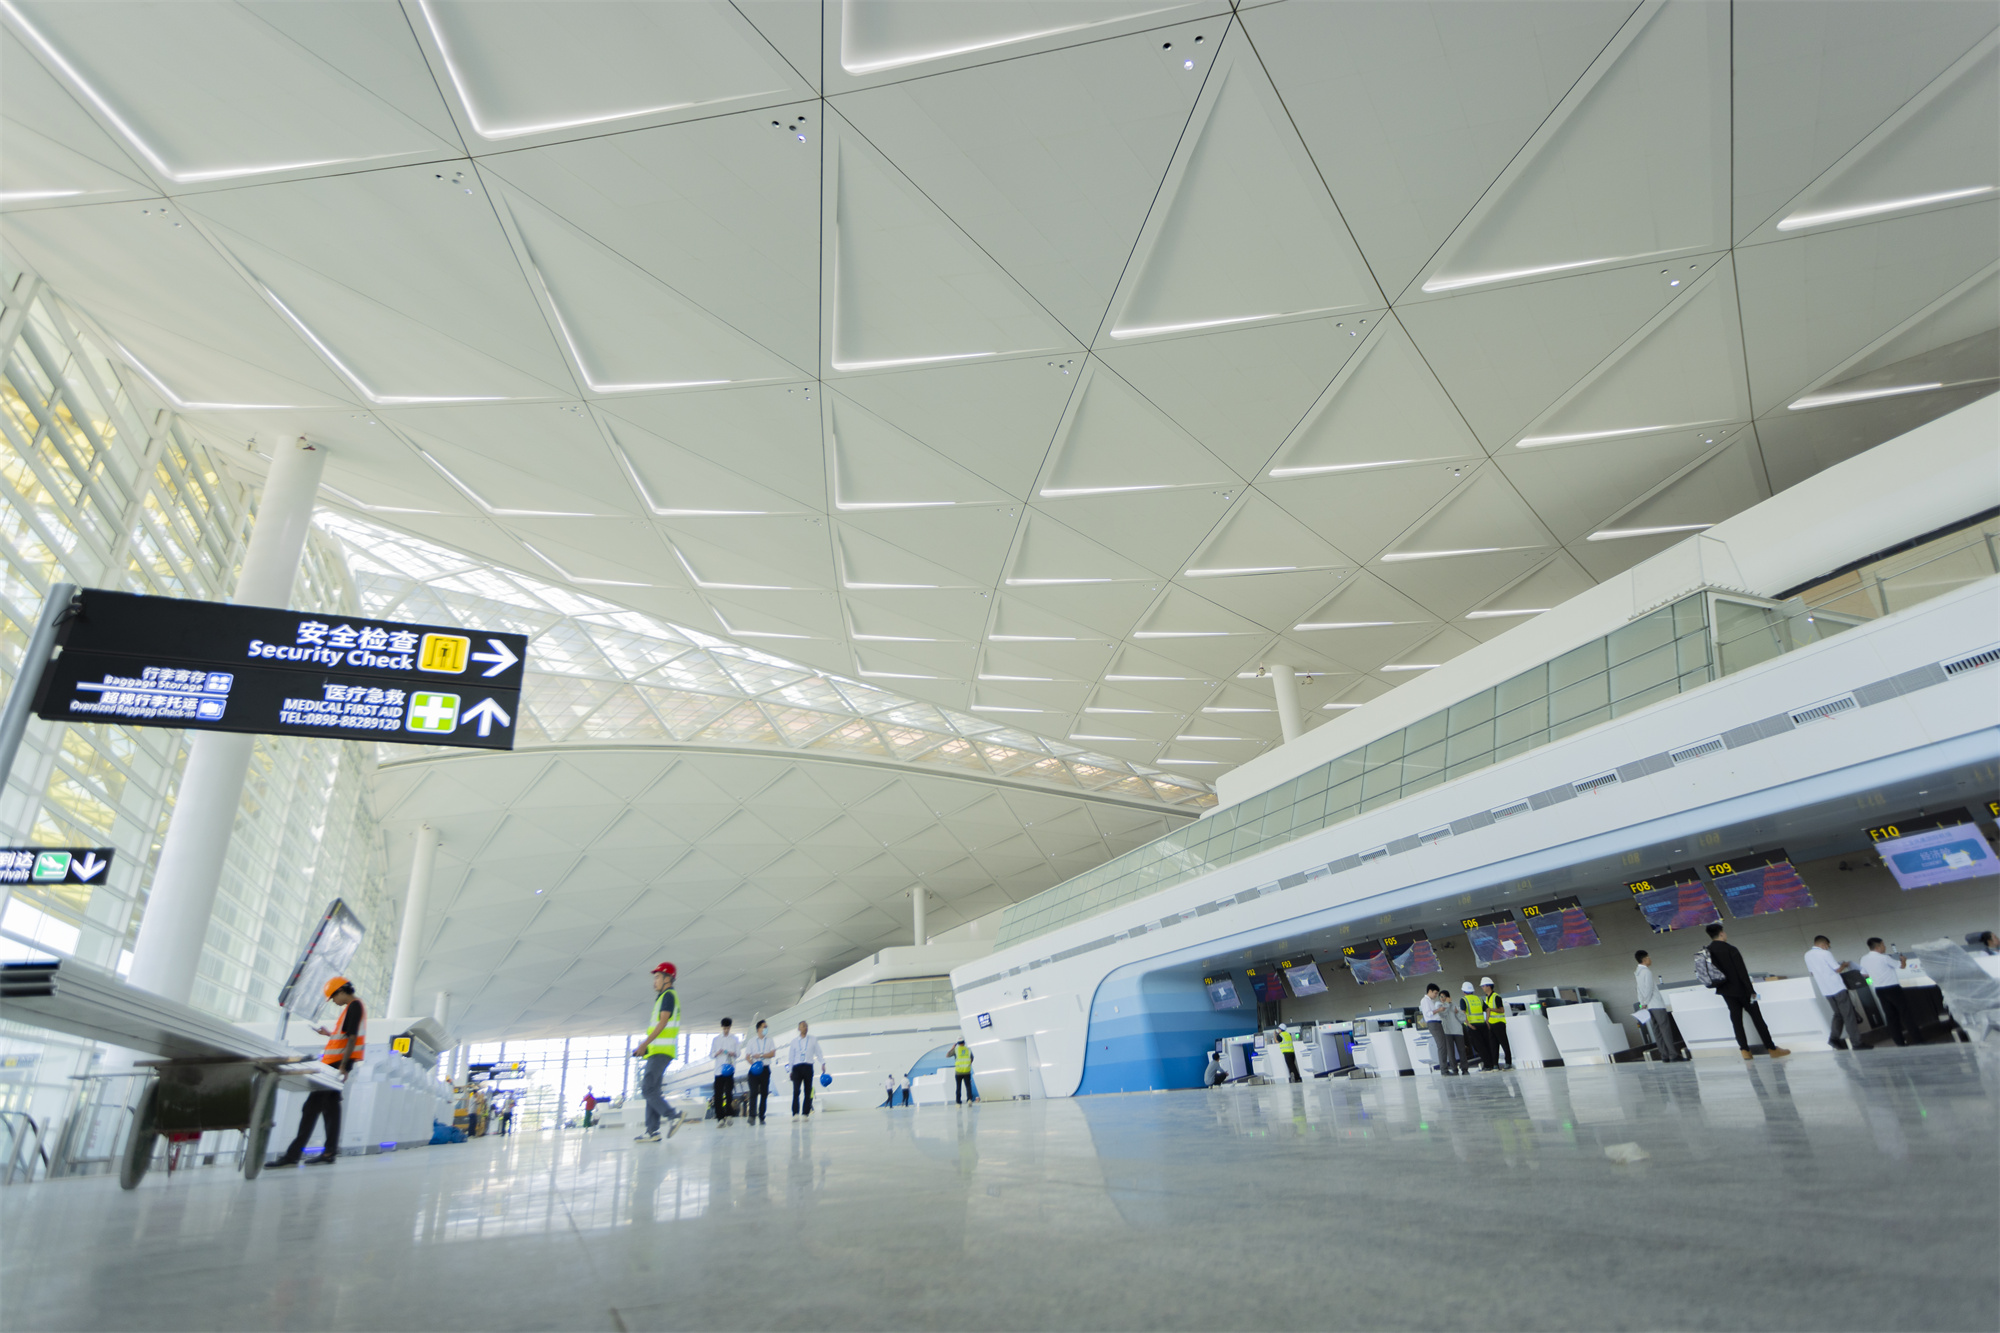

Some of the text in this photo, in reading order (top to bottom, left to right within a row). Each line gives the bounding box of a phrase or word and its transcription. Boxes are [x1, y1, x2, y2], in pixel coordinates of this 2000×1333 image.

[296, 620, 419, 653] 安全检查
[248, 639, 414, 670] Security Check
[103, 674, 204, 692] Baggage Storage
[142, 667, 207, 685] 行李寄存
[100, 691, 200, 710] 超规行李托运
[324, 684, 406, 706] 医疗急救
[70, 699, 117, 714] Oversized
[157, 707, 196, 719] Check-in
[283, 698, 403, 718] MEDICAL FIRST AID
[280, 710, 401, 730] TEL:0898-88289120
[1870, 825, 1900, 842] F10
[0, 867, 30, 882] rivals
[1708, 862, 1732, 875] F09
[1630, 881, 1651, 893] F08
[1523, 905, 1539, 917] F07
[1462, 918, 1478, 929] F06
[1343, 946, 1355, 955] F04
[1384, 937, 1397, 946] F05
